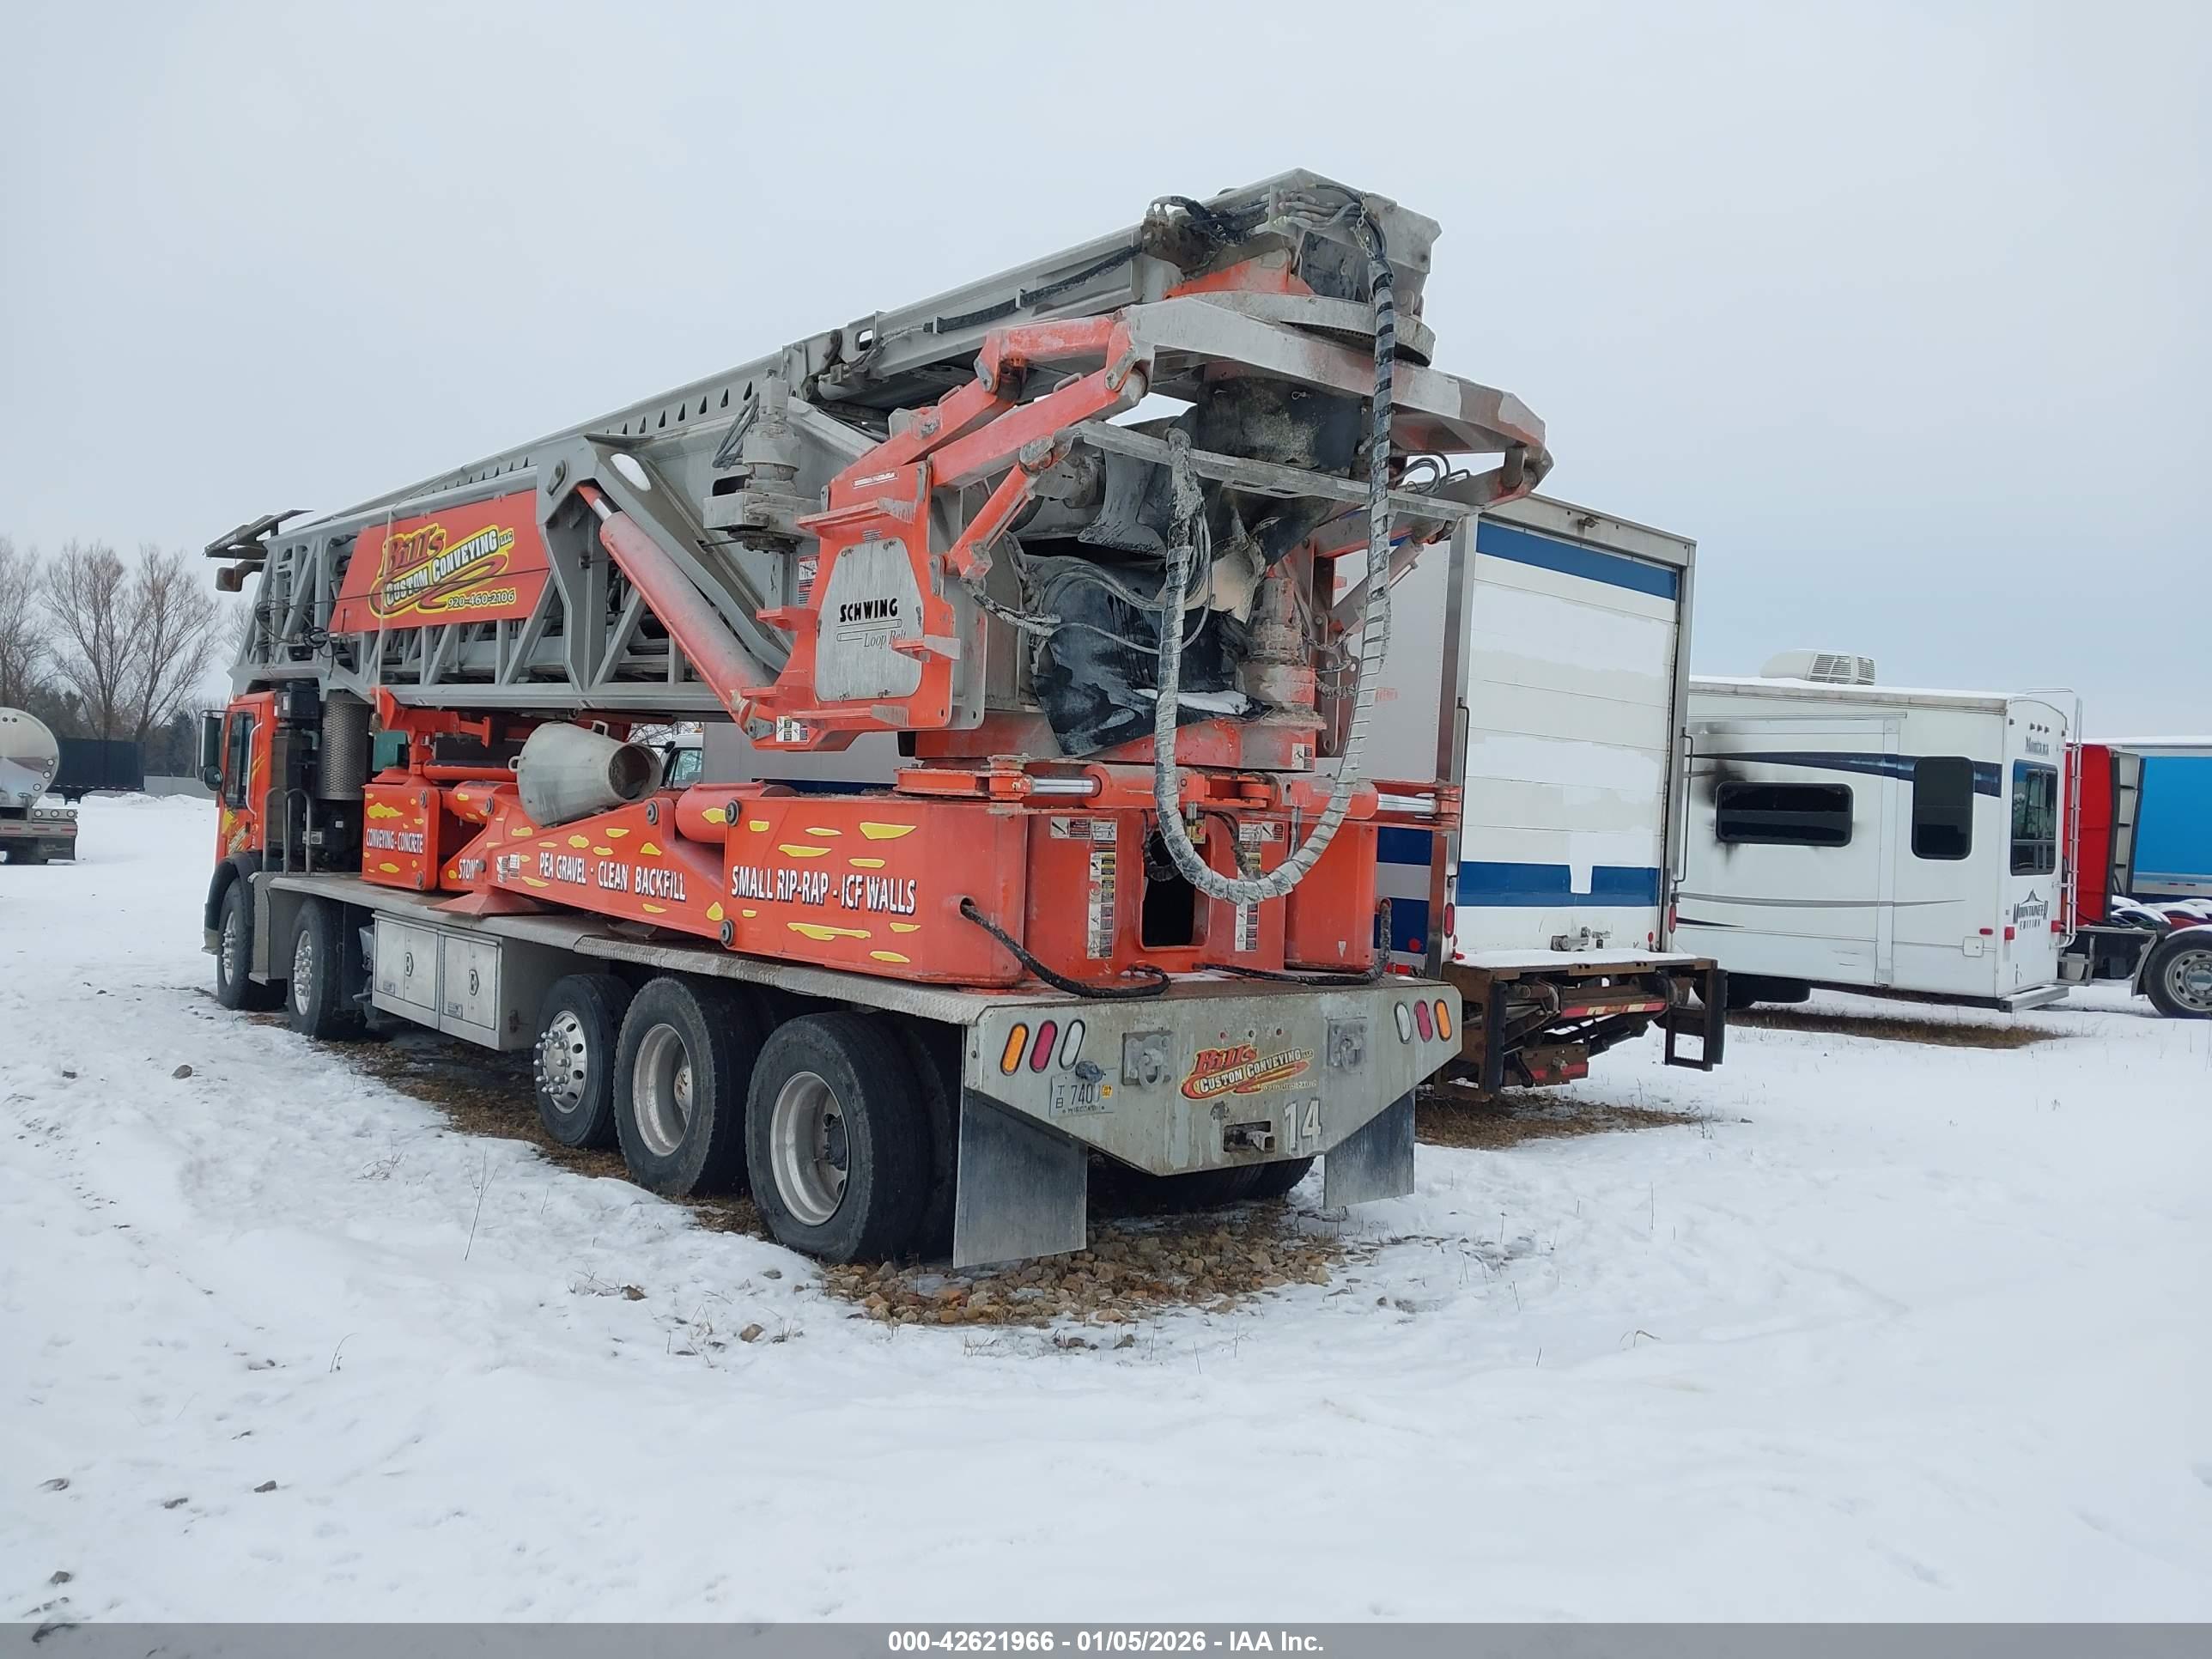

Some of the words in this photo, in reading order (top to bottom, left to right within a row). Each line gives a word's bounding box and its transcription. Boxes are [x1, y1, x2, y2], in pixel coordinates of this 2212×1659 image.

[386, 567, 428, 606] CUSTOM
[432, 529, 498, 584] CONVEYING
[500, 533, 513, 546] LLC
[447, 591, 515, 609] 920-460-2106
[839, 598, 898, 623] SCHWING
[864, 632, 886, 649] Loop
[2026, 735, 2049, 756] Montana
[366, 829, 394, 850] CONVEYING
[398, 831, 423, 854] CONCRETE
[538, 851, 554, 878] PEA
[556, 854, 586, 884] GRAVEL
[598, 860, 629, 891] CLEAN
[635, 866, 687, 901] BACKFILL
[732, 865, 774, 899] SMALL
[776, 869, 830, 905] RIP-RAP
[841, 873, 865, 909] ICF
[866, 875, 917, 915] WALLS
[2013, 901, 2049, 924] MOUNTAINEER
[1200, 1068, 1243, 1093] CUSTOM
[1245, 1048, 1302, 1079] CONVEYING
[1284, 1097, 1322, 1153] 14
